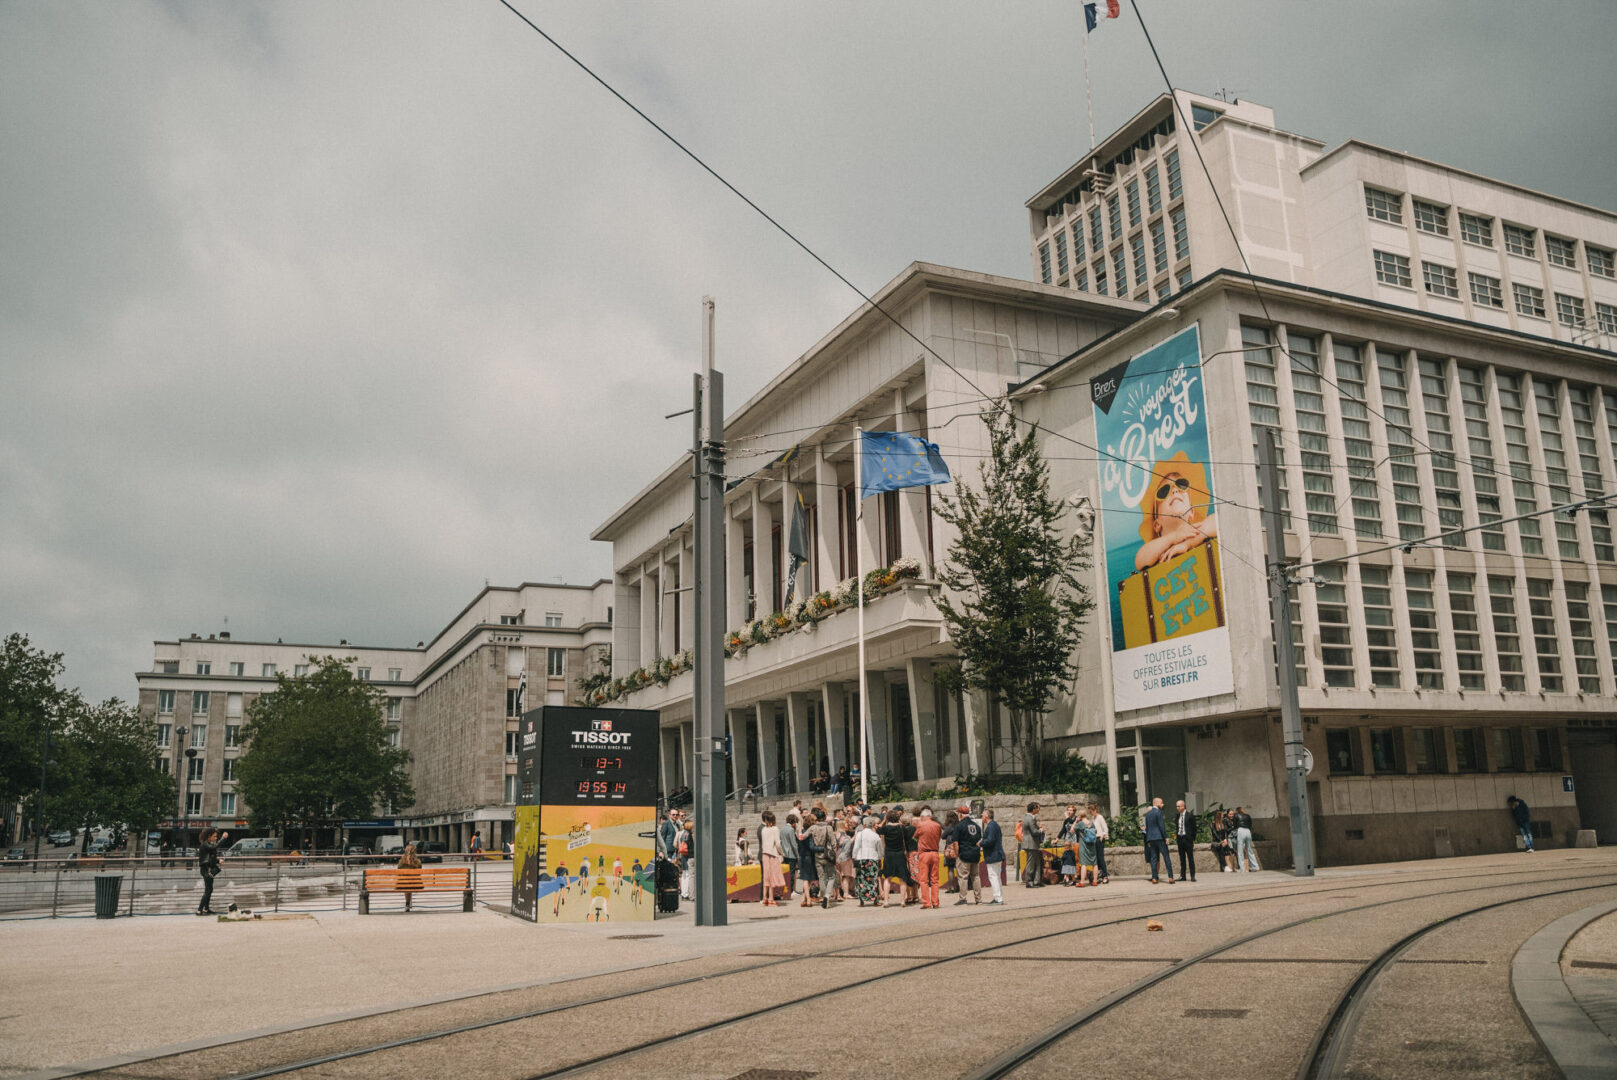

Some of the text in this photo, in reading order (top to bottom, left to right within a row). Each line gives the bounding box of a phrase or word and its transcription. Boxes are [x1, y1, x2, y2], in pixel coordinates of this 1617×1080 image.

[1139, 362, 1187, 423] voyagez
[1104, 375, 1198, 508] à Brest
[1154, 555, 1197, 602] CET
[1161, 582, 1209, 637] ÉTÉ
[1133, 655, 1208, 680] OFFRES ESTIVALES
[1144, 645, 1192, 664] TOUTES LES
[1143, 671, 1199, 691] SUR BREST.FR
[571, 731, 632, 744] TISSOT
